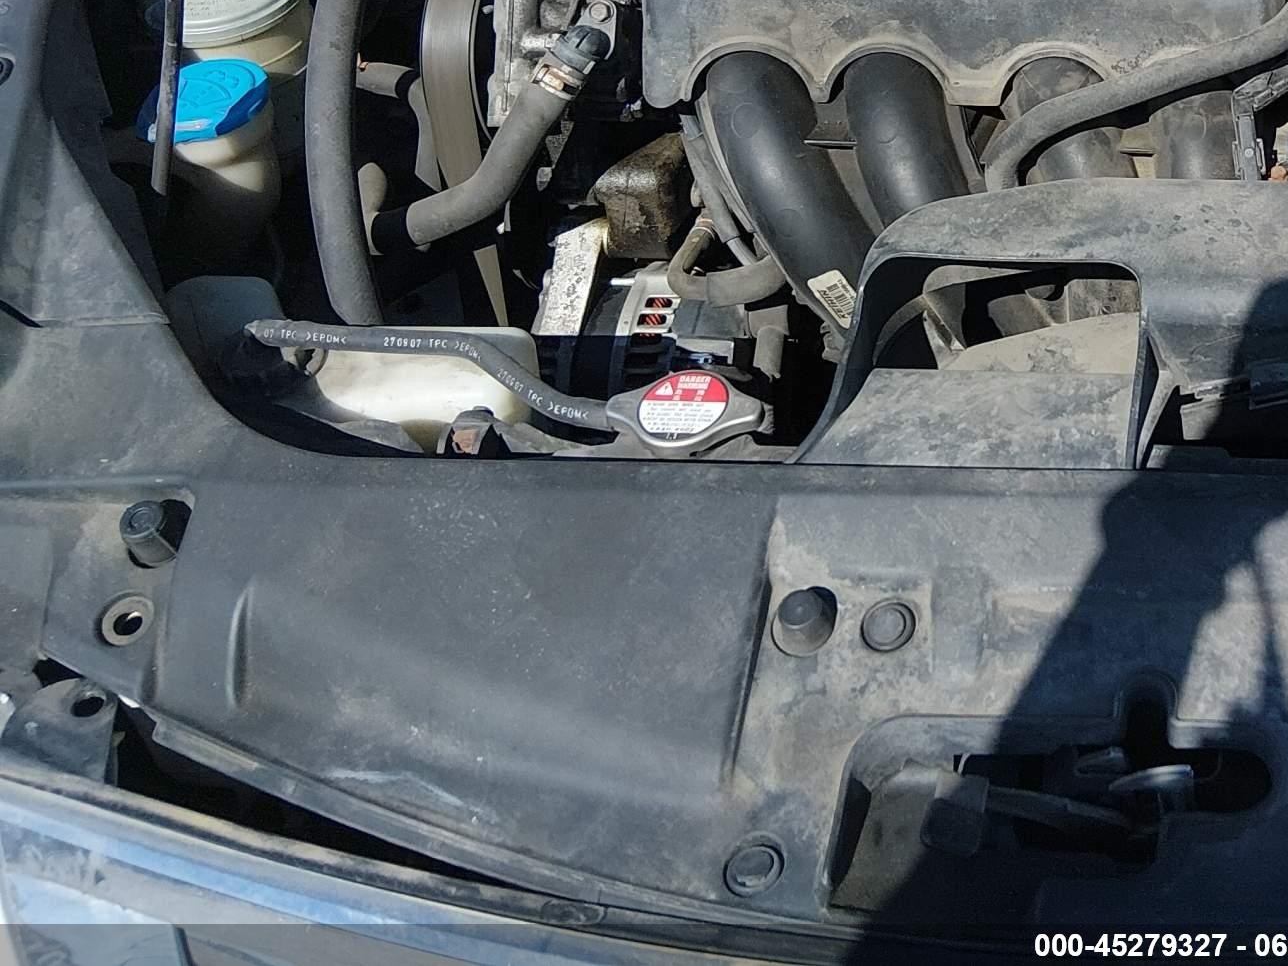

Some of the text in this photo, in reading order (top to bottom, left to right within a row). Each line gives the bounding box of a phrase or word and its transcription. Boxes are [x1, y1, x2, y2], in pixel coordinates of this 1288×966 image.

[819, 289, 849, 319] KEIHIN
[280, 329, 297, 340] TPC
[429, 338, 448, 349] TPC
